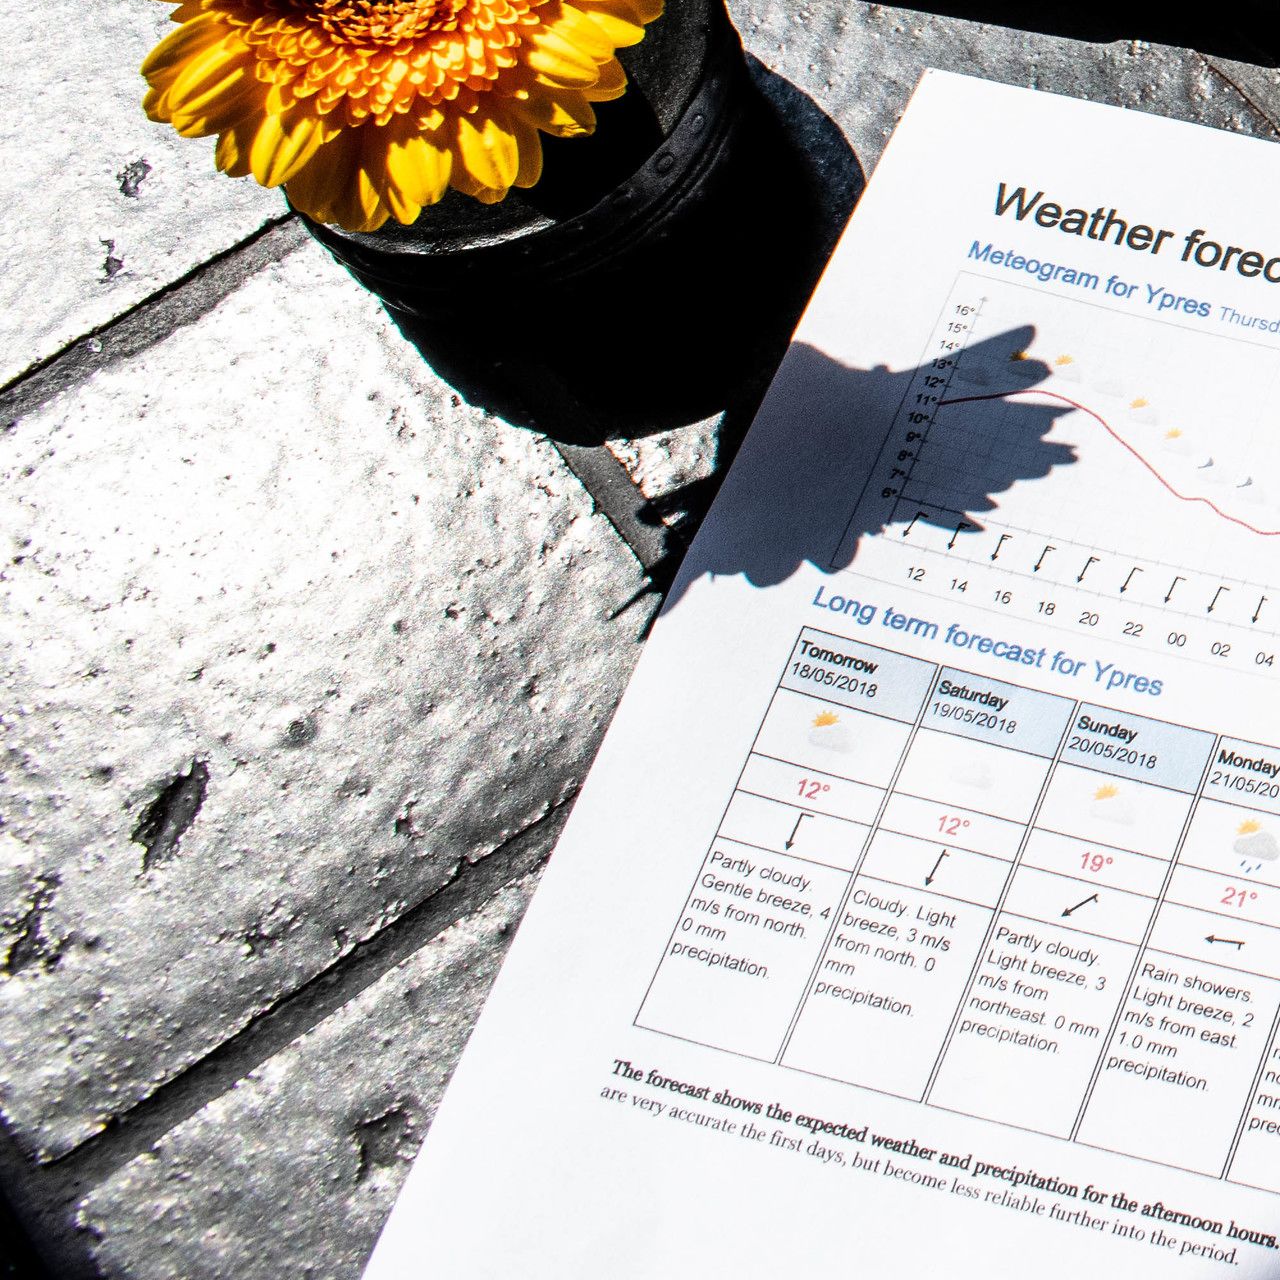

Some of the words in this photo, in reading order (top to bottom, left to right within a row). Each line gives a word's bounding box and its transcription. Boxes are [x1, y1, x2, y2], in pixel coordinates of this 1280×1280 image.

[994, 182, 1175, 255] Weather
[967, 240, 1099, 290] Meteogram
[1105, 275, 1139, 299] for
[1146, 283, 1212, 317] Ypres
[907, 566, 926, 582] 12
[950, 578, 968, 593] 14
[994, 589, 1013, 605] 16
[1038, 601, 1056, 616] 18
[800, 639, 879, 675] Tomorrow
[811, 586, 878, 626] Long
[882, 607, 939, 640] term
[944, 623, 1046, 668] forecast
[1050, 650, 1087, 677] for
[1094, 660, 1164, 696] Ypres
[793, 662, 878, 698] 18/05/2018
[937, 680, 1009, 712] Saturday
[933, 702, 1017, 734] 19/05/2018
[1077, 715, 1139, 745] Sunday
[1068, 736, 1158, 770] 20/05/2018
[709, 851, 756, 877] Partly
[759, 867, 812, 893] cloudy.
[600, 1087, 628, 1103] are
[632, 1095, 667, 1117] very
[668, 1107, 737, 1134] accurate
[740, 1123, 766, 1142] the
[769, 1130, 803, 1152] first
[806, 1140, 846, 1167] days,
[851, 1151, 881, 1173] but
[883, 1160, 947, 1191] become
[950, 1177, 981, 1200] less
[984, 1190, 1046, 1216] reliable
[1048, 1203, 1109, 1231] further
[1111, 1219, 1146, 1241] into
[1150, 1230, 1177, 1249] the
[1178, 1241, 1239, 1266] period.
